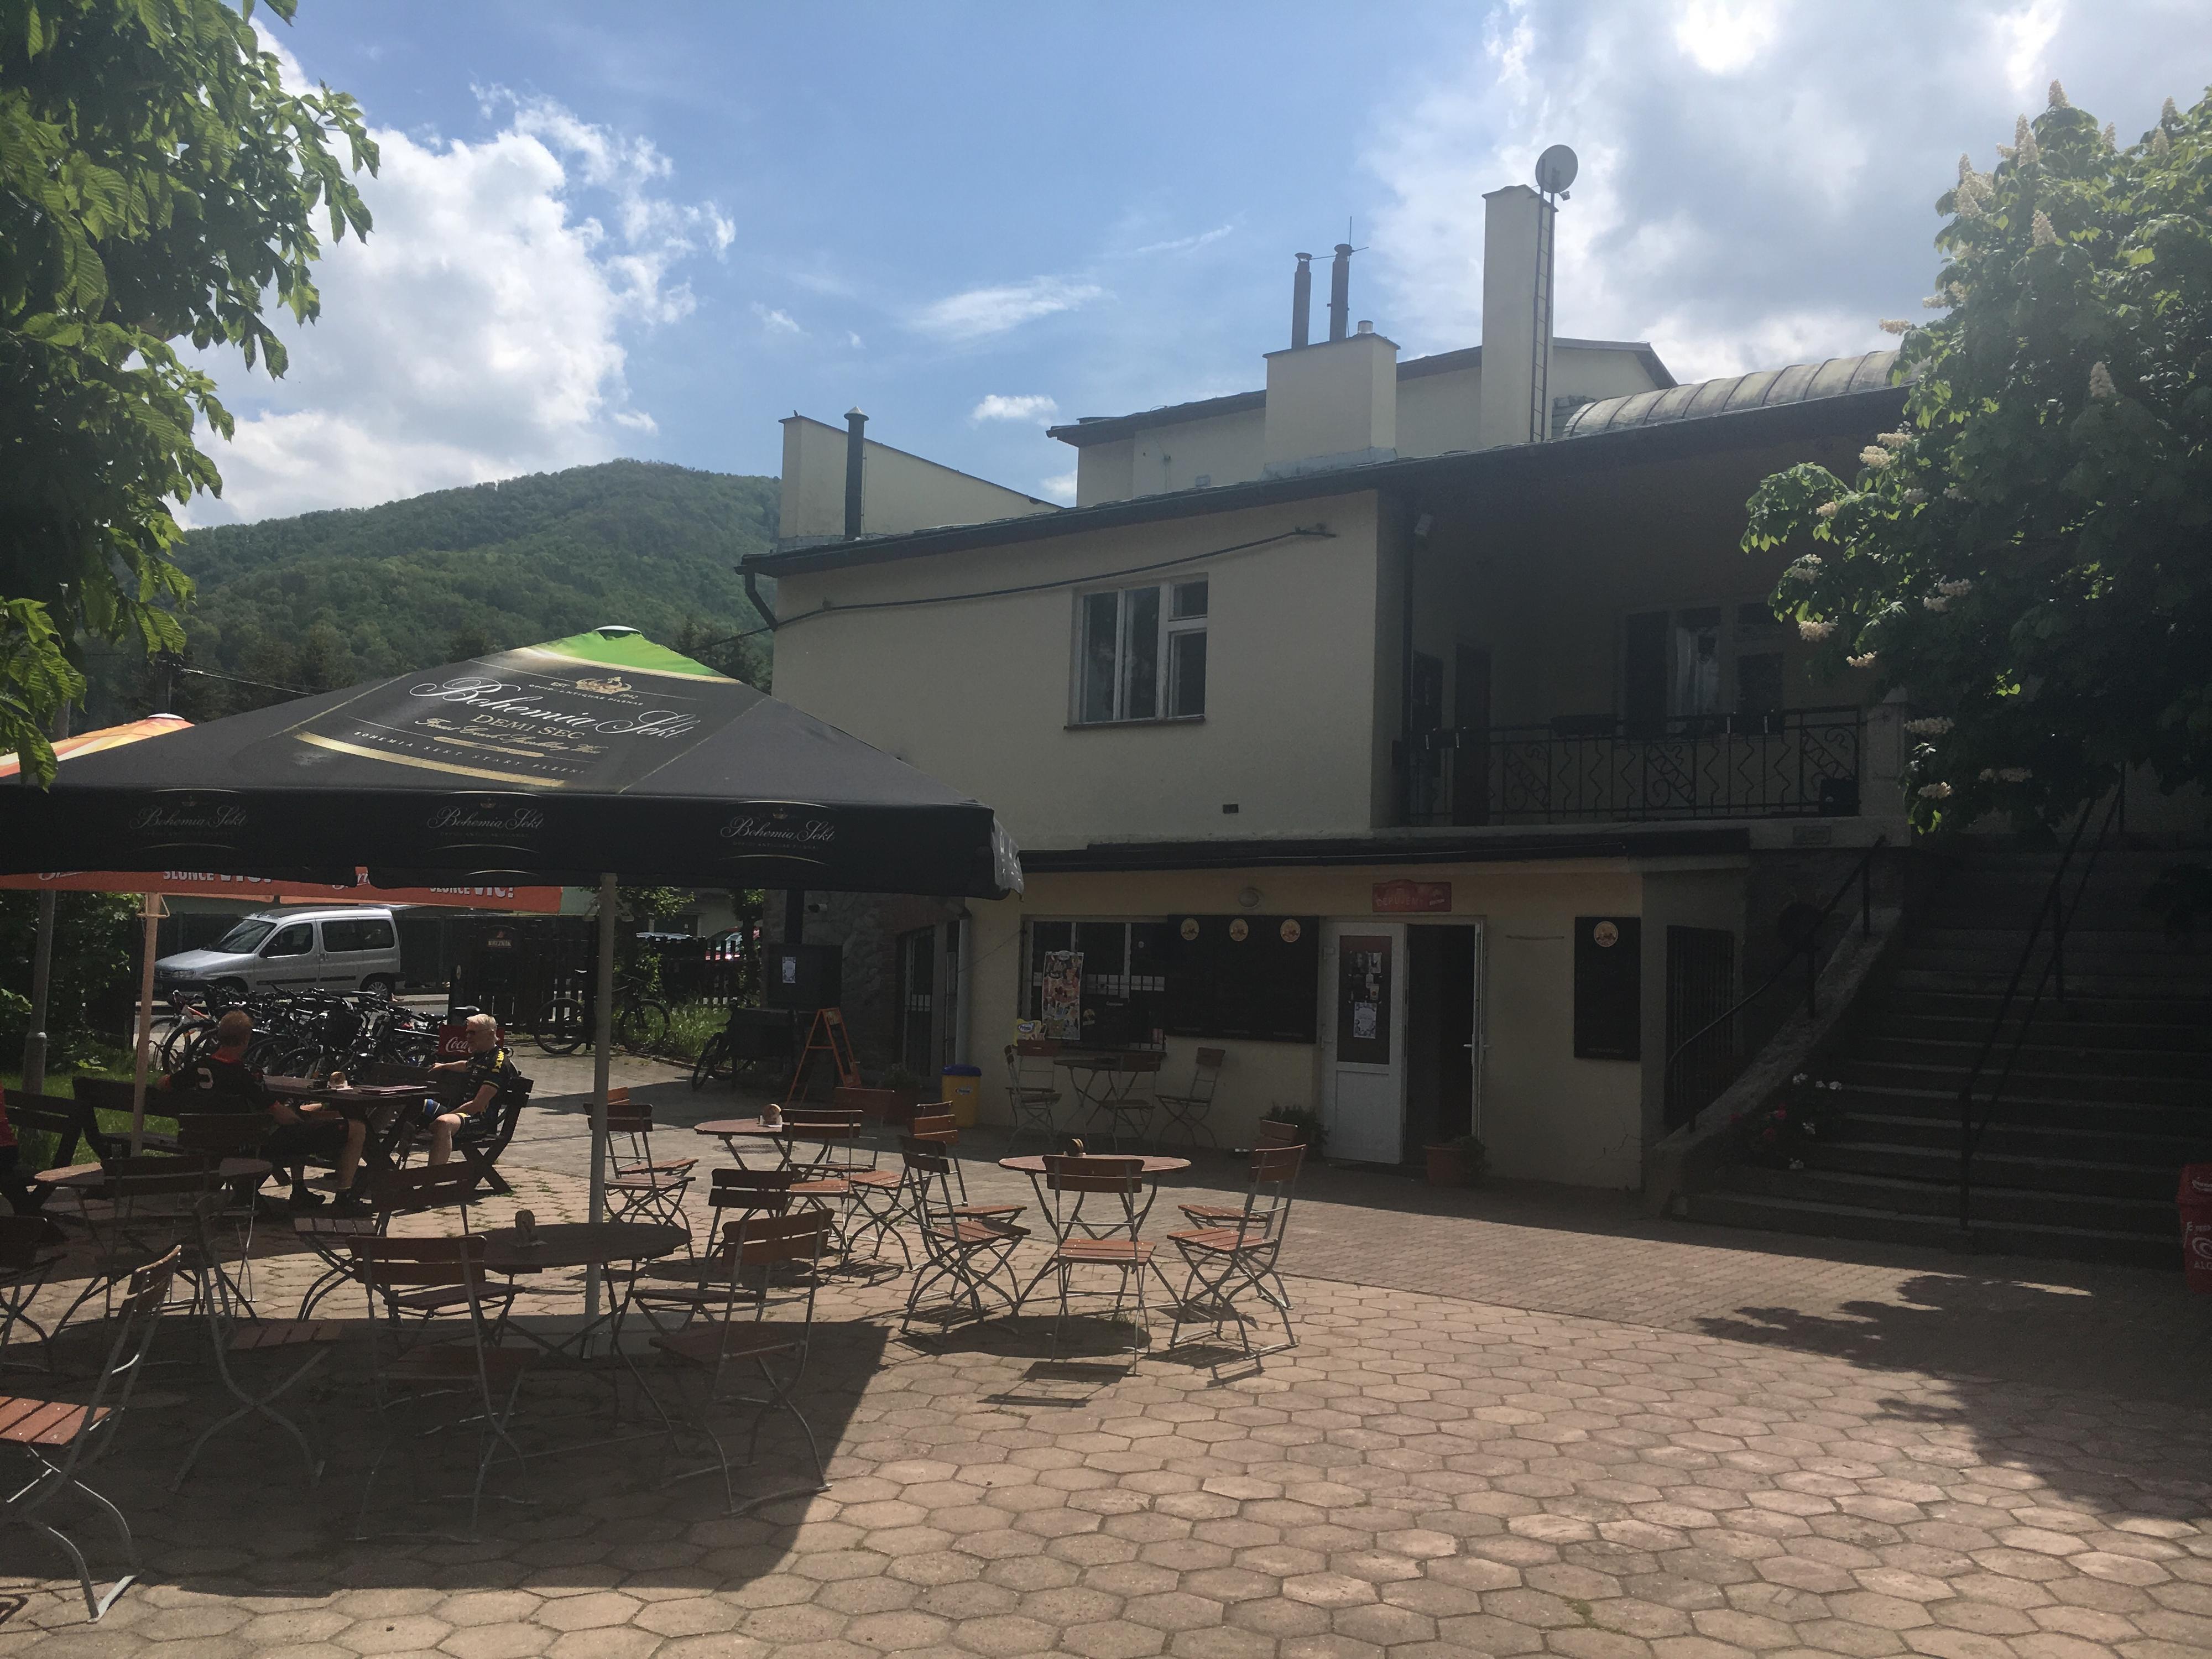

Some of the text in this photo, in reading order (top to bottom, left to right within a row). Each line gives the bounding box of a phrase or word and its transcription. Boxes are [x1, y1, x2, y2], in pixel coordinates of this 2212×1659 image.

[410, 677, 701, 739] Bohemia Sekt
[354, 731, 413, 747] BOHEMIA
[471, 714, 585, 739] DEMI SEC
[130, 805, 247, 830] Bohemia Sekt
[427, 805, 544, 830] Bohemia Sekt
[720, 815, 836, 842] Bohemia Sekt
